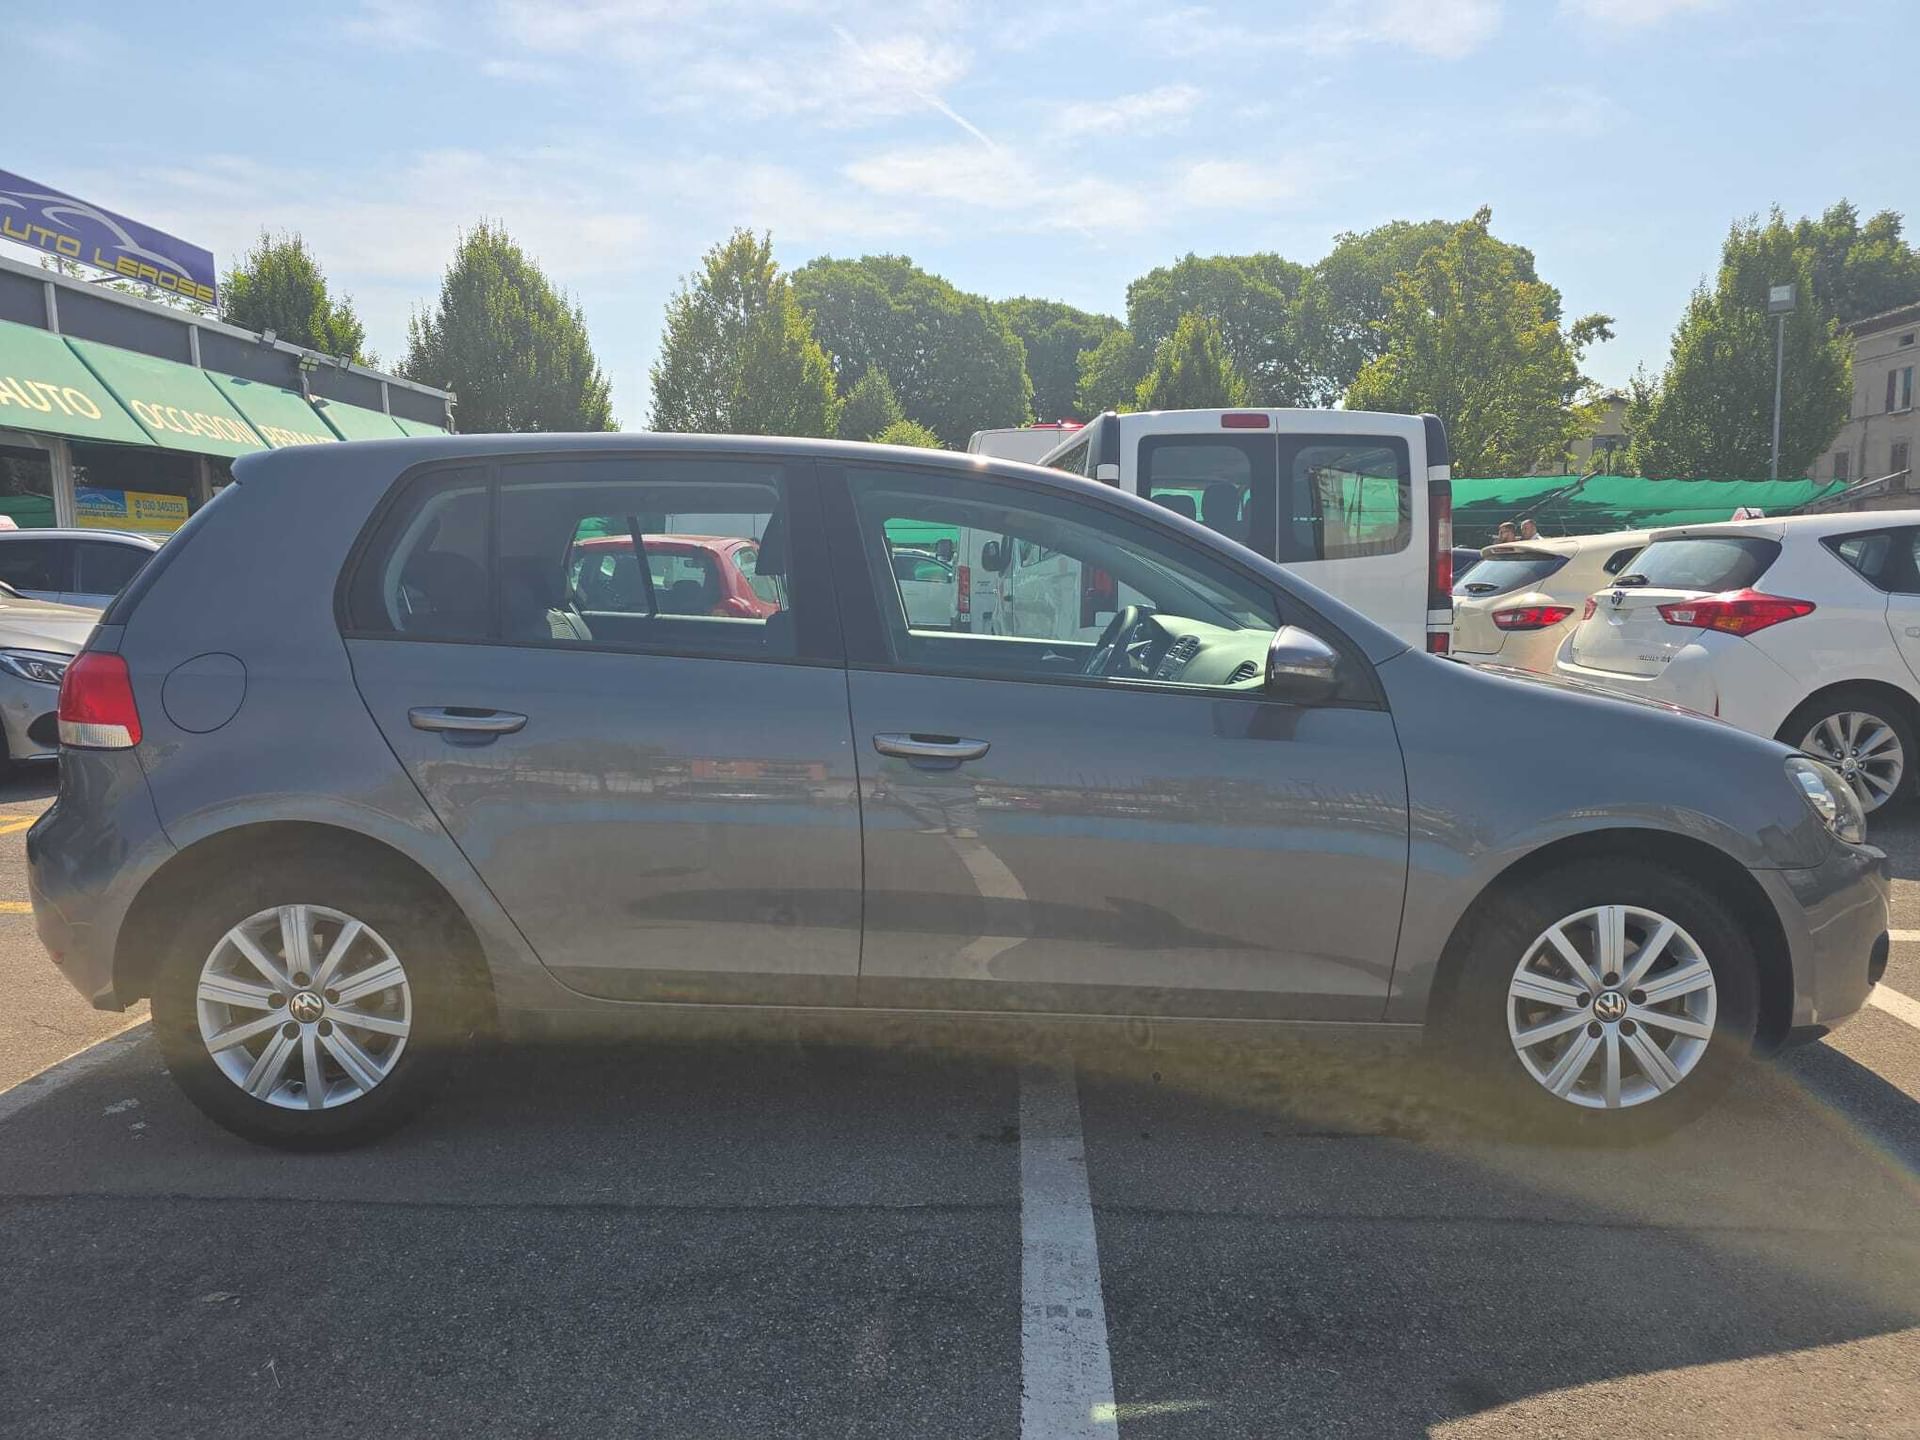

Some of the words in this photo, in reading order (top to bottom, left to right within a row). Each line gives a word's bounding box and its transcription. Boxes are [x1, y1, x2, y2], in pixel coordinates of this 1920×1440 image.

[0, 216, 81, 257] UTO
[94, 248, 214, 301] LEROSE
[0, 377, 102, 420] AUTO
[131, 400, 260, 446] OCCASIONI
